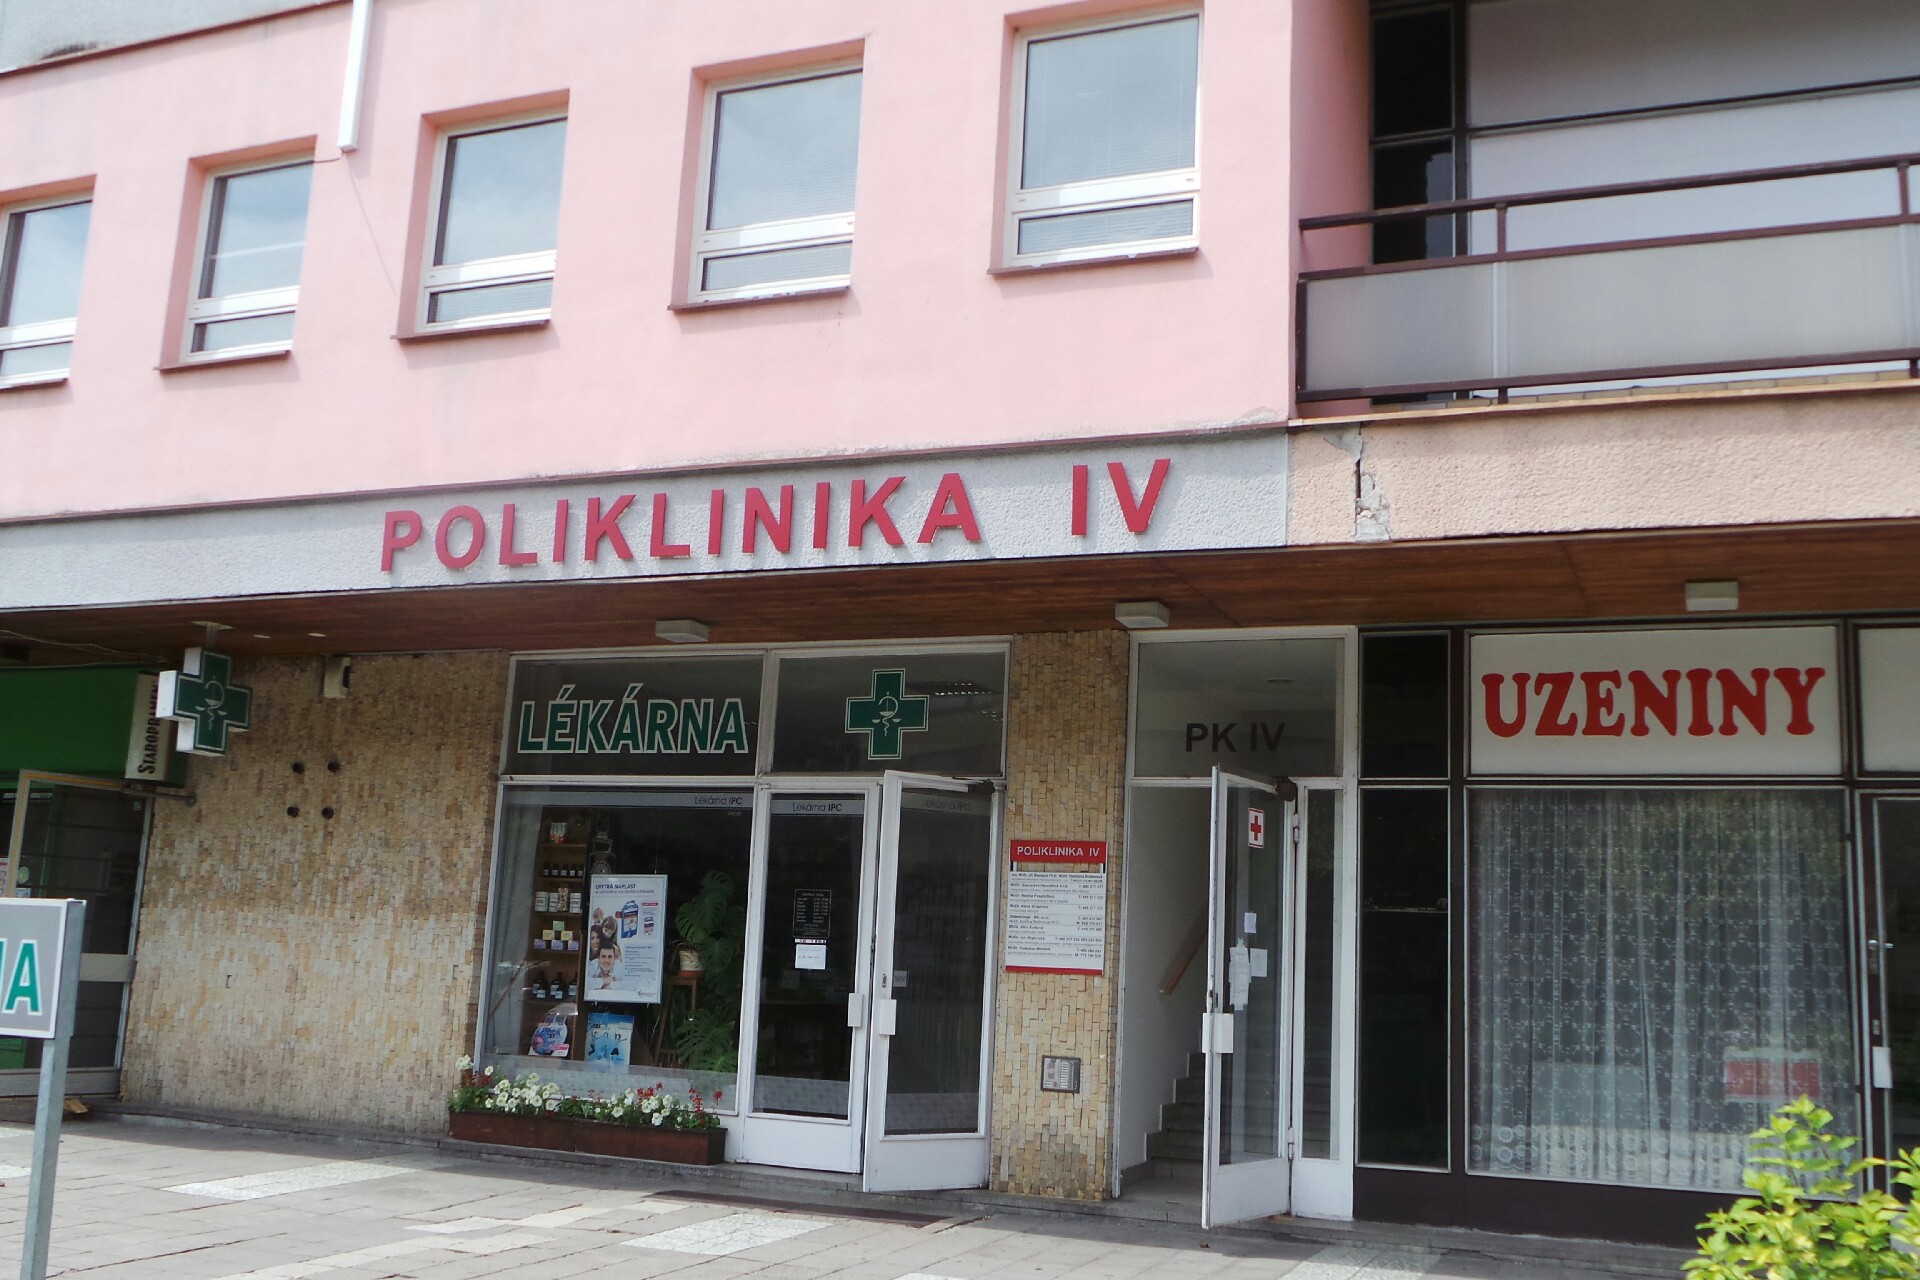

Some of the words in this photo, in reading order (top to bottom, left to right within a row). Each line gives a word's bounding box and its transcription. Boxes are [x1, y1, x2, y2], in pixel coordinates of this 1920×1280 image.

[381, 472, 981, 571] POLIKLINIKA
[1071, 458, 1171, 536] IV
[517, 683, 749, 754] LÉKÁRNA
[1185, 722, 1238, 752] PK
[1250, 722, 1286, 752] IV
[1481, 667, 1826, 738] UZENINY
[828, 803, 842, 812] IPC
[1017, 846, 1084, 857] POLIKLINIKA
[1089, 847, 1100, 857] IV
[0, 938, 42, 1016] A
